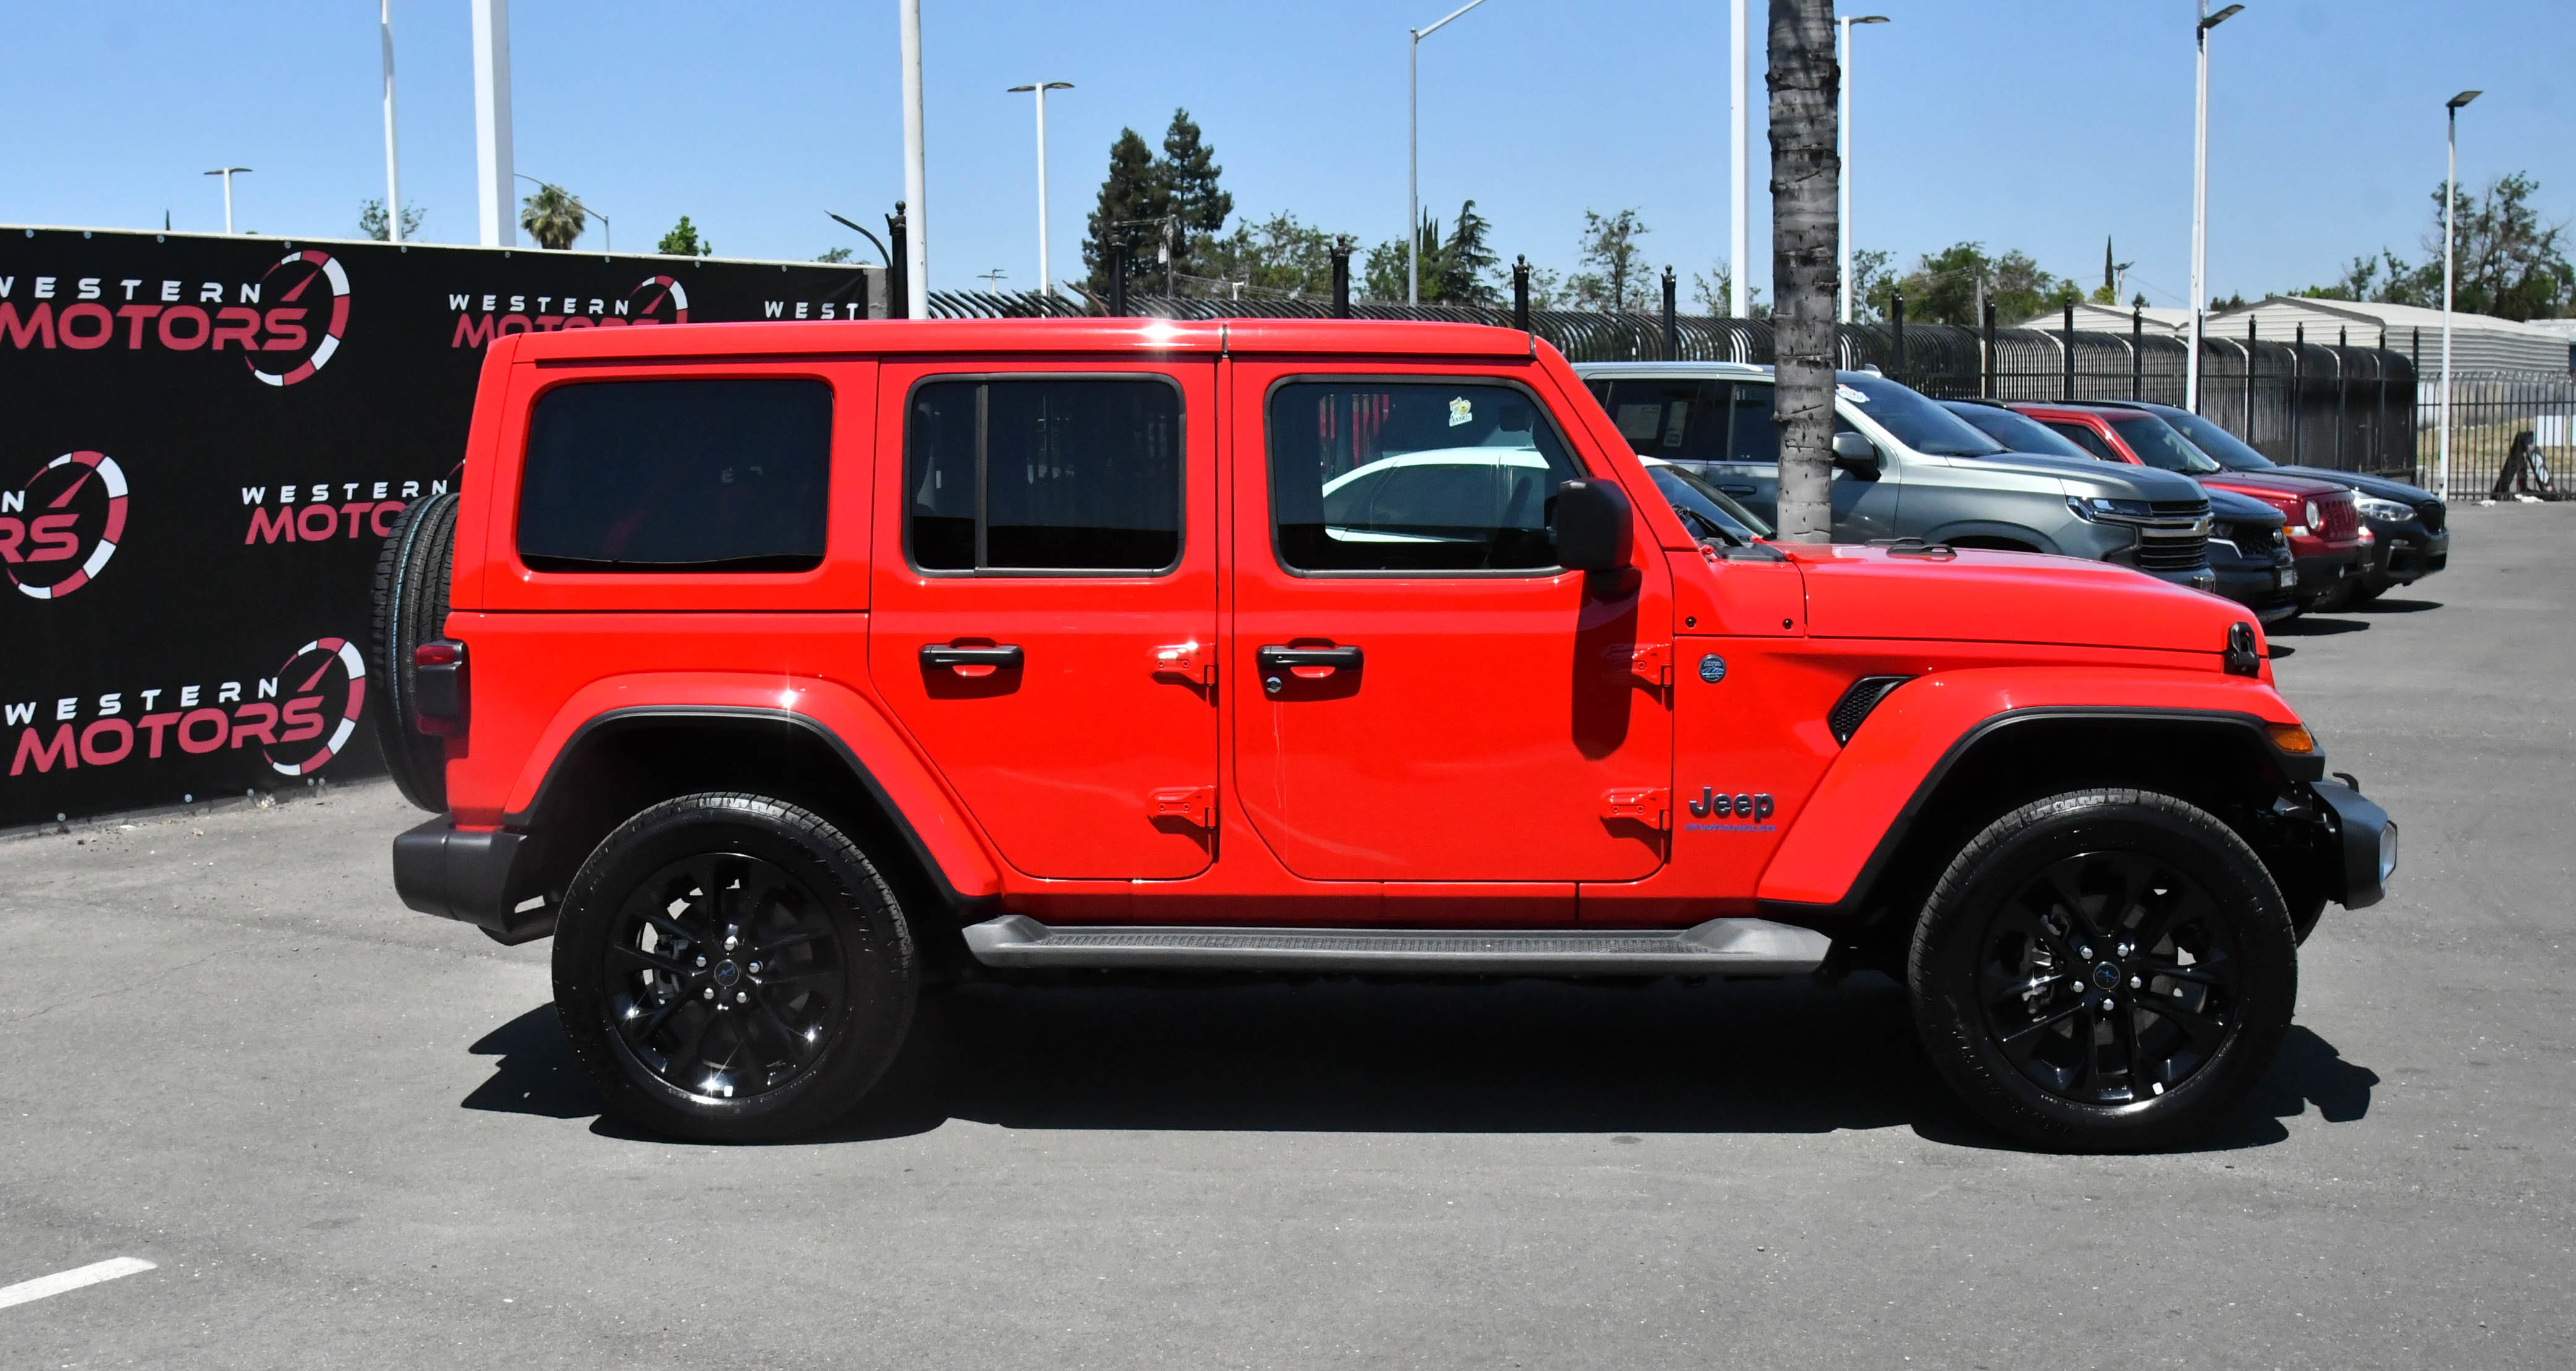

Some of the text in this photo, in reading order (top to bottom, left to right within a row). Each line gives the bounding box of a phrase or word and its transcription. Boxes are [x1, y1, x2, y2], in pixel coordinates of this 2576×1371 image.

[449, 294, 629, 315] WESTERN
[0, 301, 308, 351] MOTORS
[242, 480, 447, 505] WESTERN
[244, 500, 406, 545] MOTO
[5, 677, 278, 726] WESTERN
[9, 696, 324, 776] MOTORS
[1689, 786, 1774, 823] Jeep
[1698, 824, 1777, 832] WRANGLER
